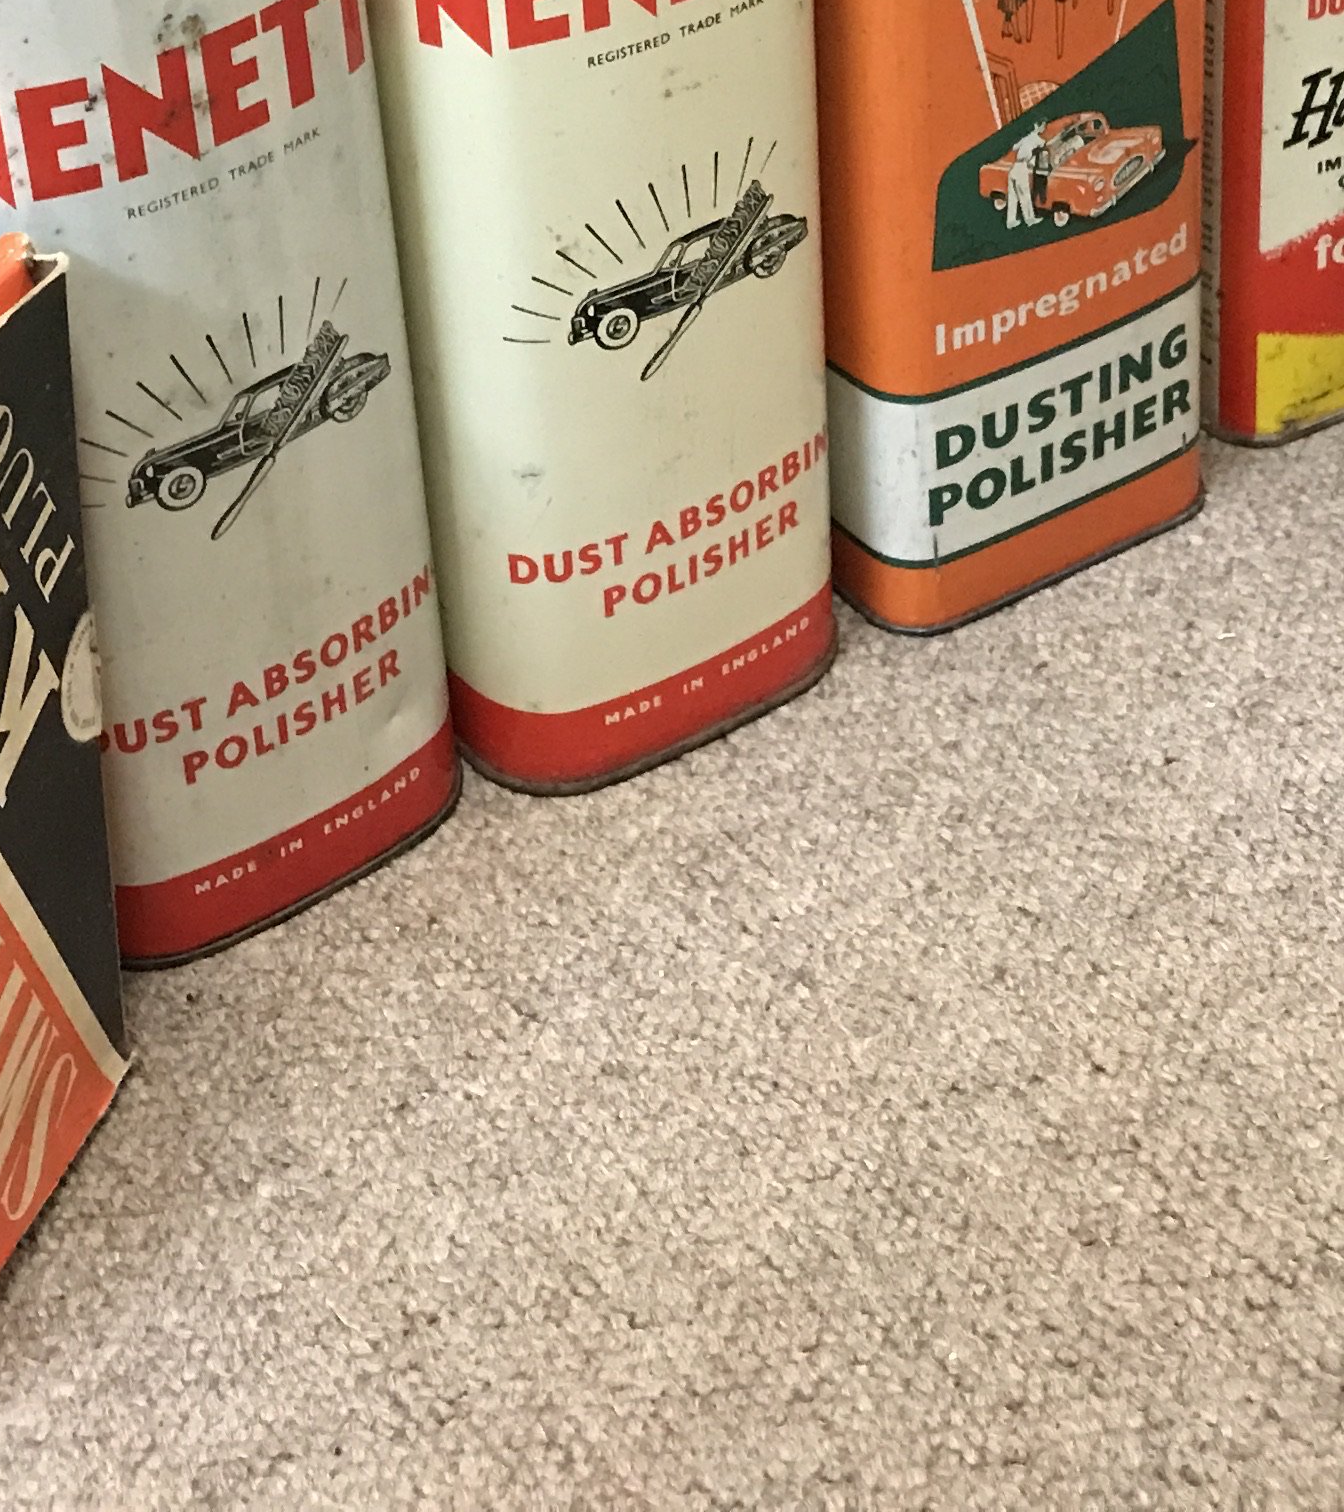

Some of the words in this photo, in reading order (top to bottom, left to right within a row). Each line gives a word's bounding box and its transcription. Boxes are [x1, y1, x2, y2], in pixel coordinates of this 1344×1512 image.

[586, 31, 672, 71] REGISTERED
[678, 12, 723, 40] TRADE
[126, 176, 221, 220] REGISTERED
[227, 149, 277, 180] TRADE
[282, 125, 323, 157] MARK
[933, 223, 1189, 357] Impregnated
[928, 378, 1192, 528] POLISHER
[934, 322, 1189, 471] DUSTING
[507, 531, 630, 586] DUST
[602, 499, 800, 619] POLISHER
[182, 648, 403, 787] POLISHER
[603, 694, 664, 727] MADE
[681, 675, 705, 696] IN
[720, 615, 811, 678] ENGLAND
[193, 859, 258, 896] MADE
[279, 837, 304, 859] IN
[322, 765, 422, 837] ENGLAND
